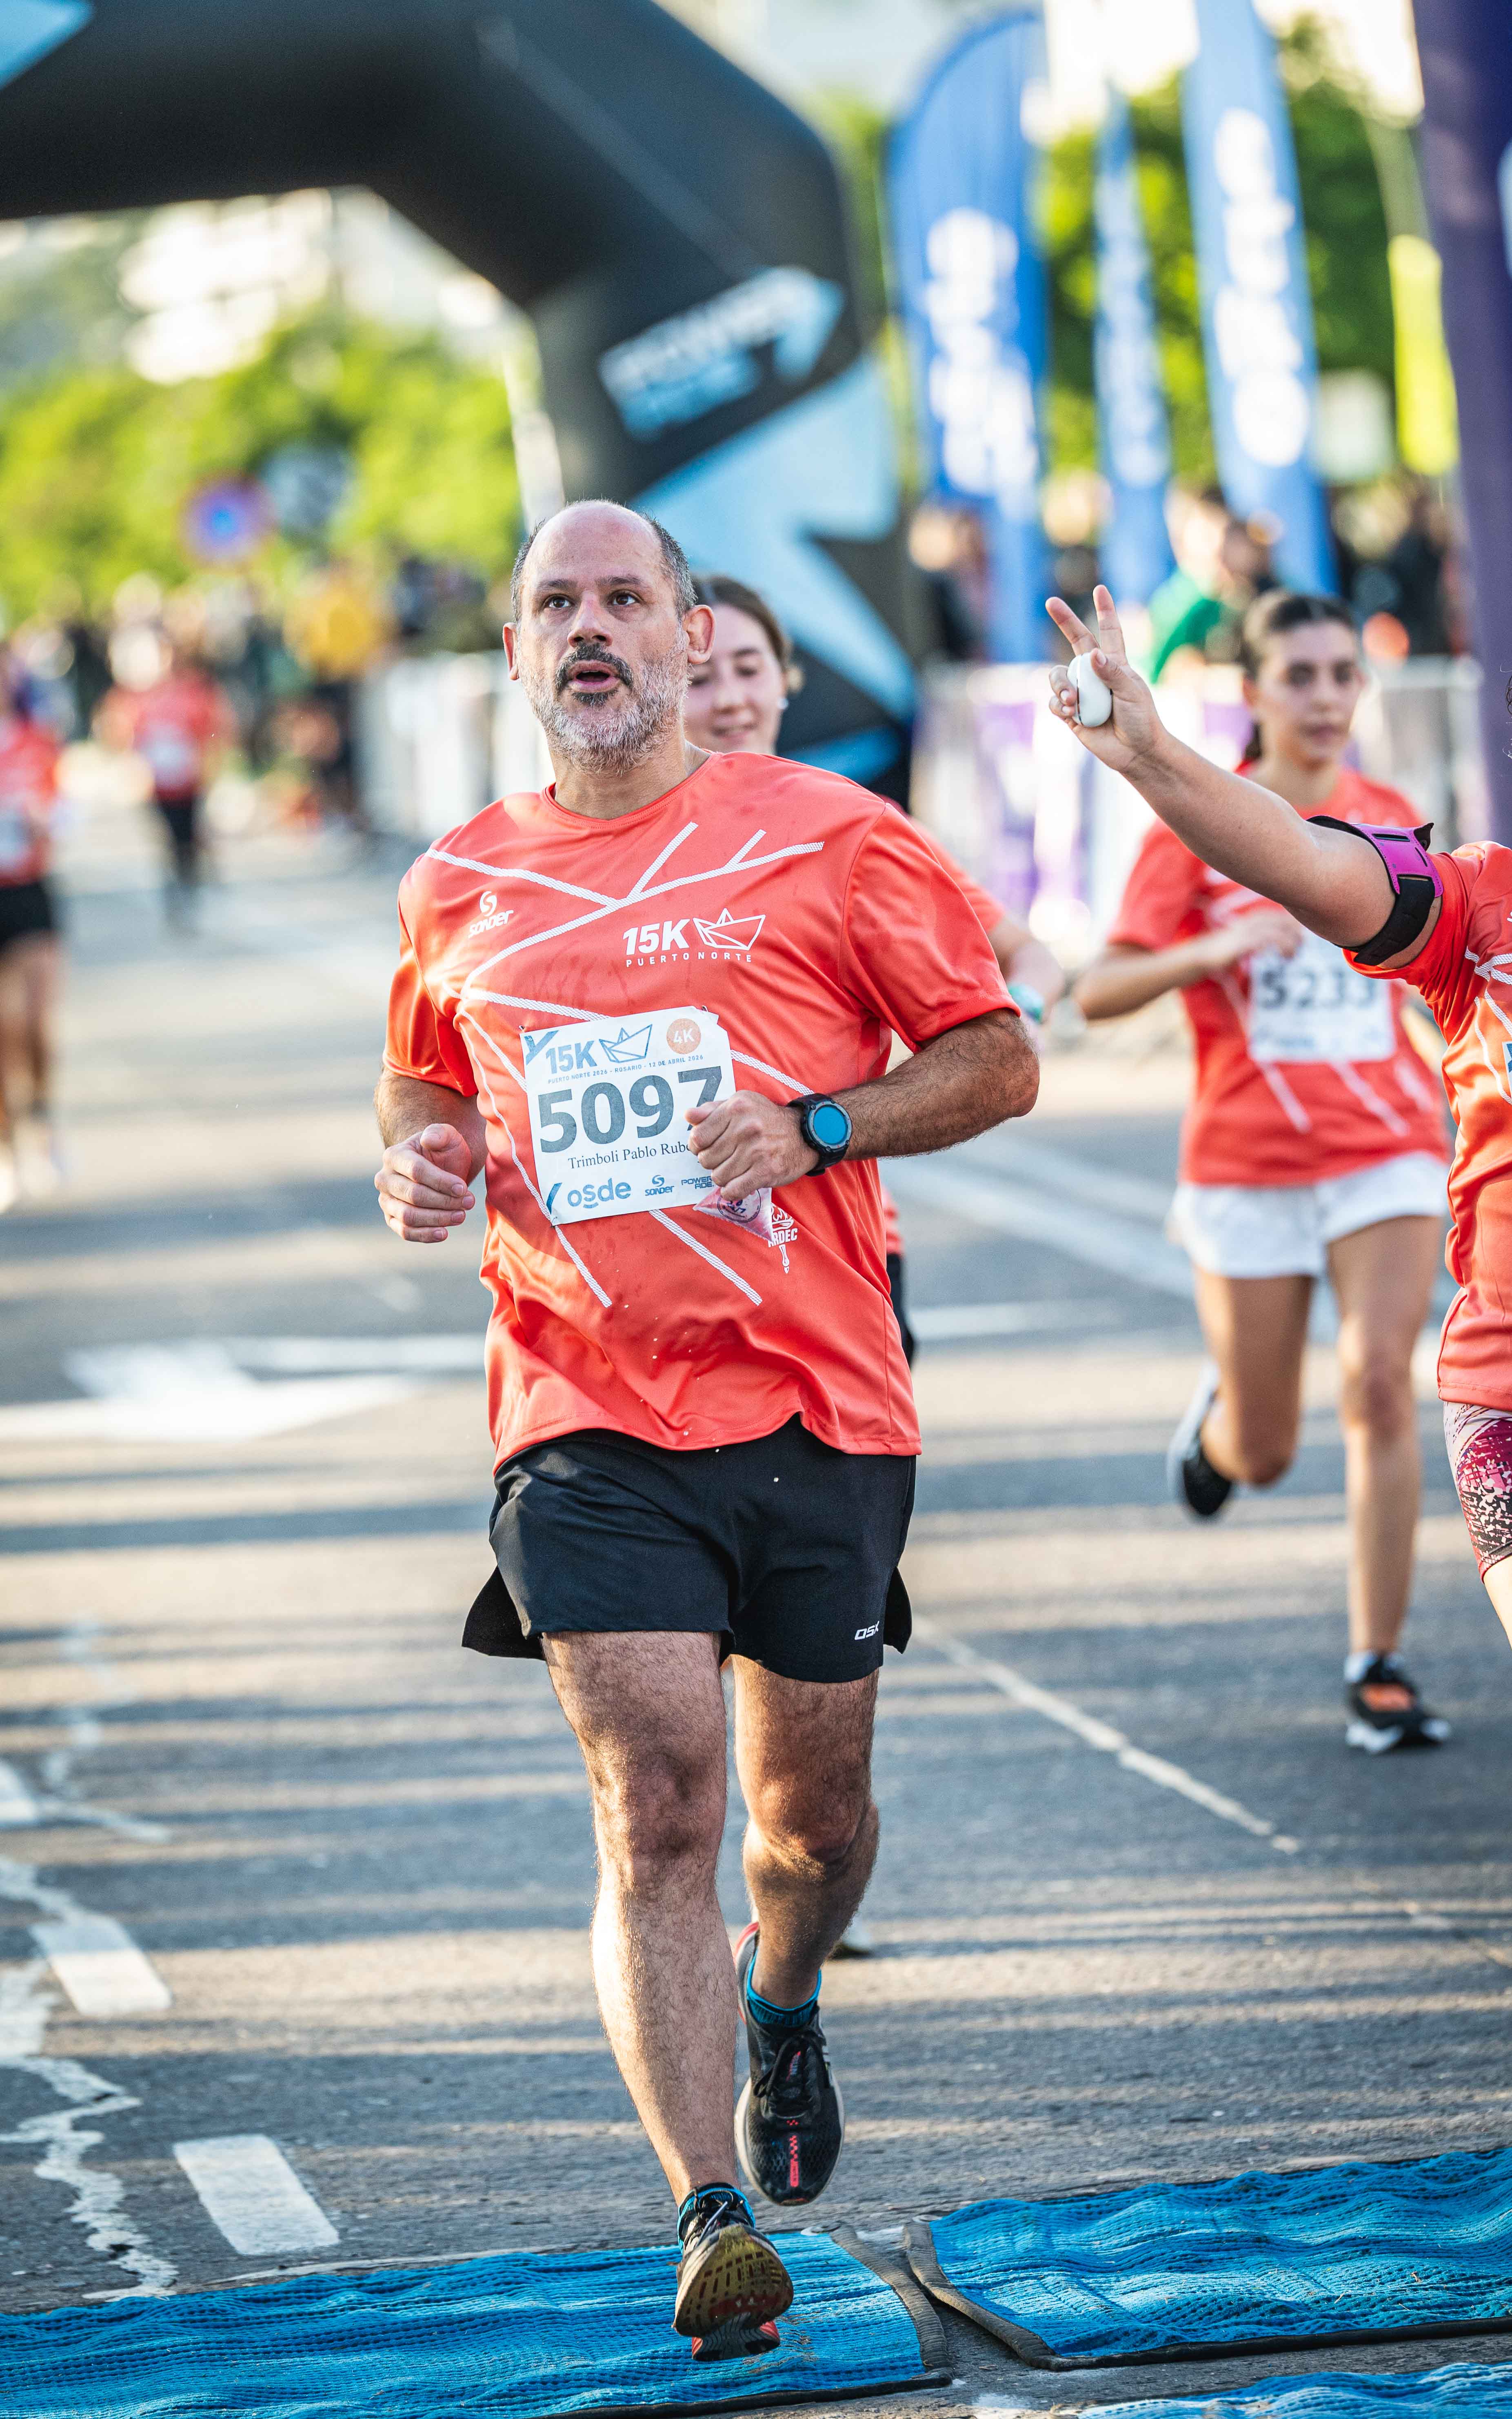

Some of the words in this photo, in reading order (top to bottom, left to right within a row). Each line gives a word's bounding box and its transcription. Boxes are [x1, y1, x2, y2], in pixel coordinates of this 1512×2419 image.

[622, 918, 691, 955] 15K
[626, 952, 690, 968] PUERTO
[697, 952, 752, 962] NORTE
[673, 1027, 695, 1044] 4K
[546, 1040, 598, 1074] 15K
[548, 1076, 570, 1084] PUERTO
[571, 1071, 591, 1080] NORTE
[615, 1064, 642, 1073] ROSARIO
[538, 1066, 722, 1153] 5097
[568, 1150, 619, 1169] Trimboli
[623, 1146, 657, 1161] Pablo
[681, 1176, 713, 1185] POWER
[567, 1178, 631, 1207] osde
